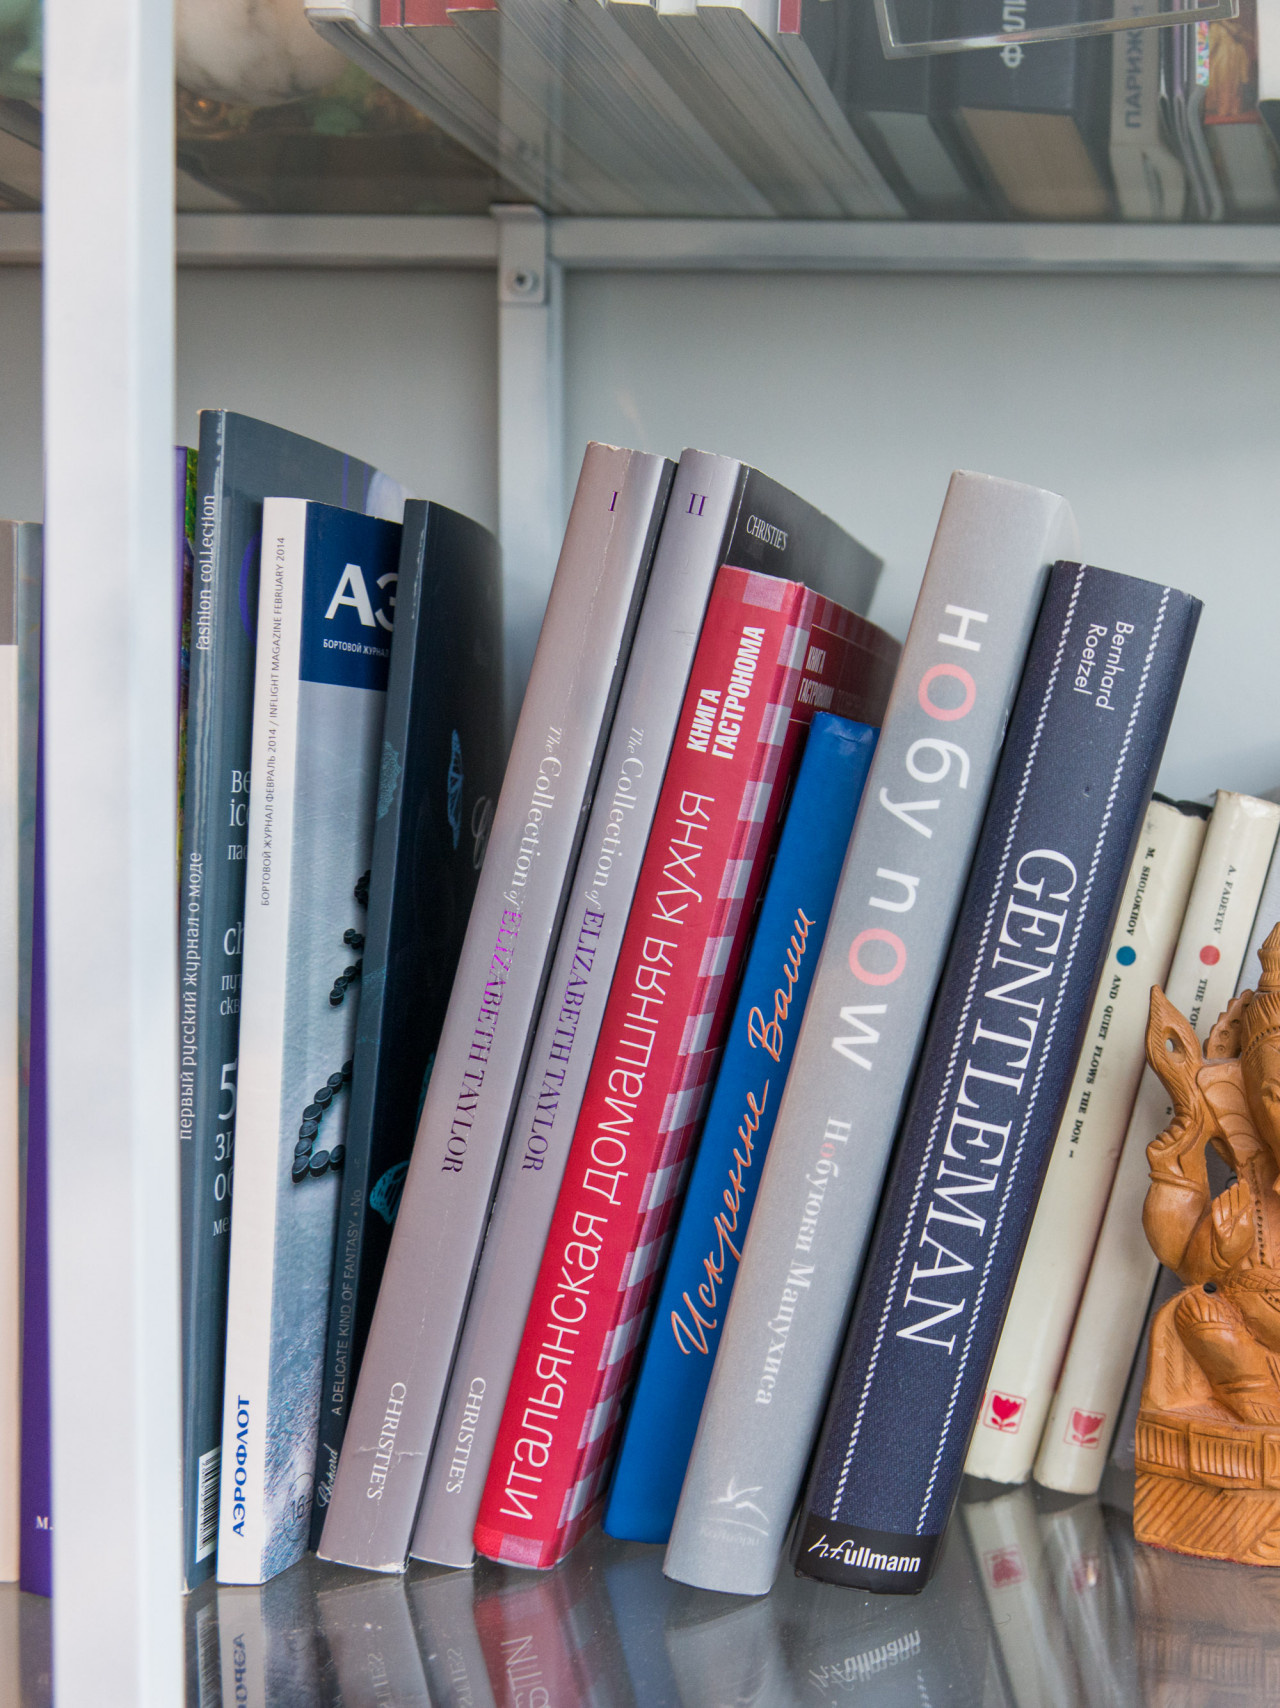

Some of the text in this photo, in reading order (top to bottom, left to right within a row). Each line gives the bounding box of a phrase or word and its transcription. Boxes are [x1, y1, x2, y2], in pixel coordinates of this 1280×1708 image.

[686, 492, 708, 517] II
[276, 536, 286, 562] 2014
[273, 563, 284, 619] FEBRUARY
[196, 589, 212, 651] fashion
[271, 620, 282, 672] MAGAZINE
[322, 637, 362, 654] БОРТОВОЙ
[1073, 623, 1108, 695] Roetzel
[1095, 621, 1134, 710] Bernhard
[269, 673, 280, 719] INFLIGHT
[686, 687, 721, 752] КНИГА
[711, 625, 766, 760] ГАСТРОНОМА
[267, 729, 277, 753] 2014
[544, 726, 562, 753] The
[265, 755, 276, 803] ФЕВРАЛЬ
[263, 804, 274, 849] ЖУРНАЛ
[511, 755, 562, 888] Collection
[189, 851, 203, 897] моде
[260, 850, 273, 906] БОРТОВОЙ
[503, 890, 520, 907] of
[1126, 865, 1151, 936] SHOLOKHOV
[1213, 880, 1234, 934] FADEYEV
[183, 911, 202, 987] журнал
[522, 726, 645, 1172] The Collection of ELIZABETH TAYLOR
[830, 866, 920, 1071] now
[468, 908, 523, 1064] ELIZABETH
[747, 906, 817, 1062] Ваши
[1108, 974, 1122, 1000] AND
[1194, 978, 1208, 1002] THE
[181, 990, 198, 1071] русский
[1097, 1004, 1113, 1040] QUIET
[1086, 1045, 1103, 1085] FLOWS
[180, 1072, 196, 1141] первый
[441, 1069, 486, 1173] TAYLOR
[896, 848, 1078, 1354] GENTLEMAN
[1078, 1090, 1091, 1114] THE
[1070, 1119, 1084, 1145] DON
[344, 1219, 360, 1279] FANTASY
[755, 1115, 853, 1405] Нобуюки Мацухиса
[341, 1281, 354, 1300] OF
[338, 1302, 351, 1337] KIND
[332, 1339, 349, 1403] DELICATE
[331, 1405, 343, 1416] A
[445, 1376, 487, 1494] CHRISTIE'S
[232, 1394, 250, 1538] АЭРОФЛОТ
[367, 1381, 407, 1501] CHRISTIE'S
